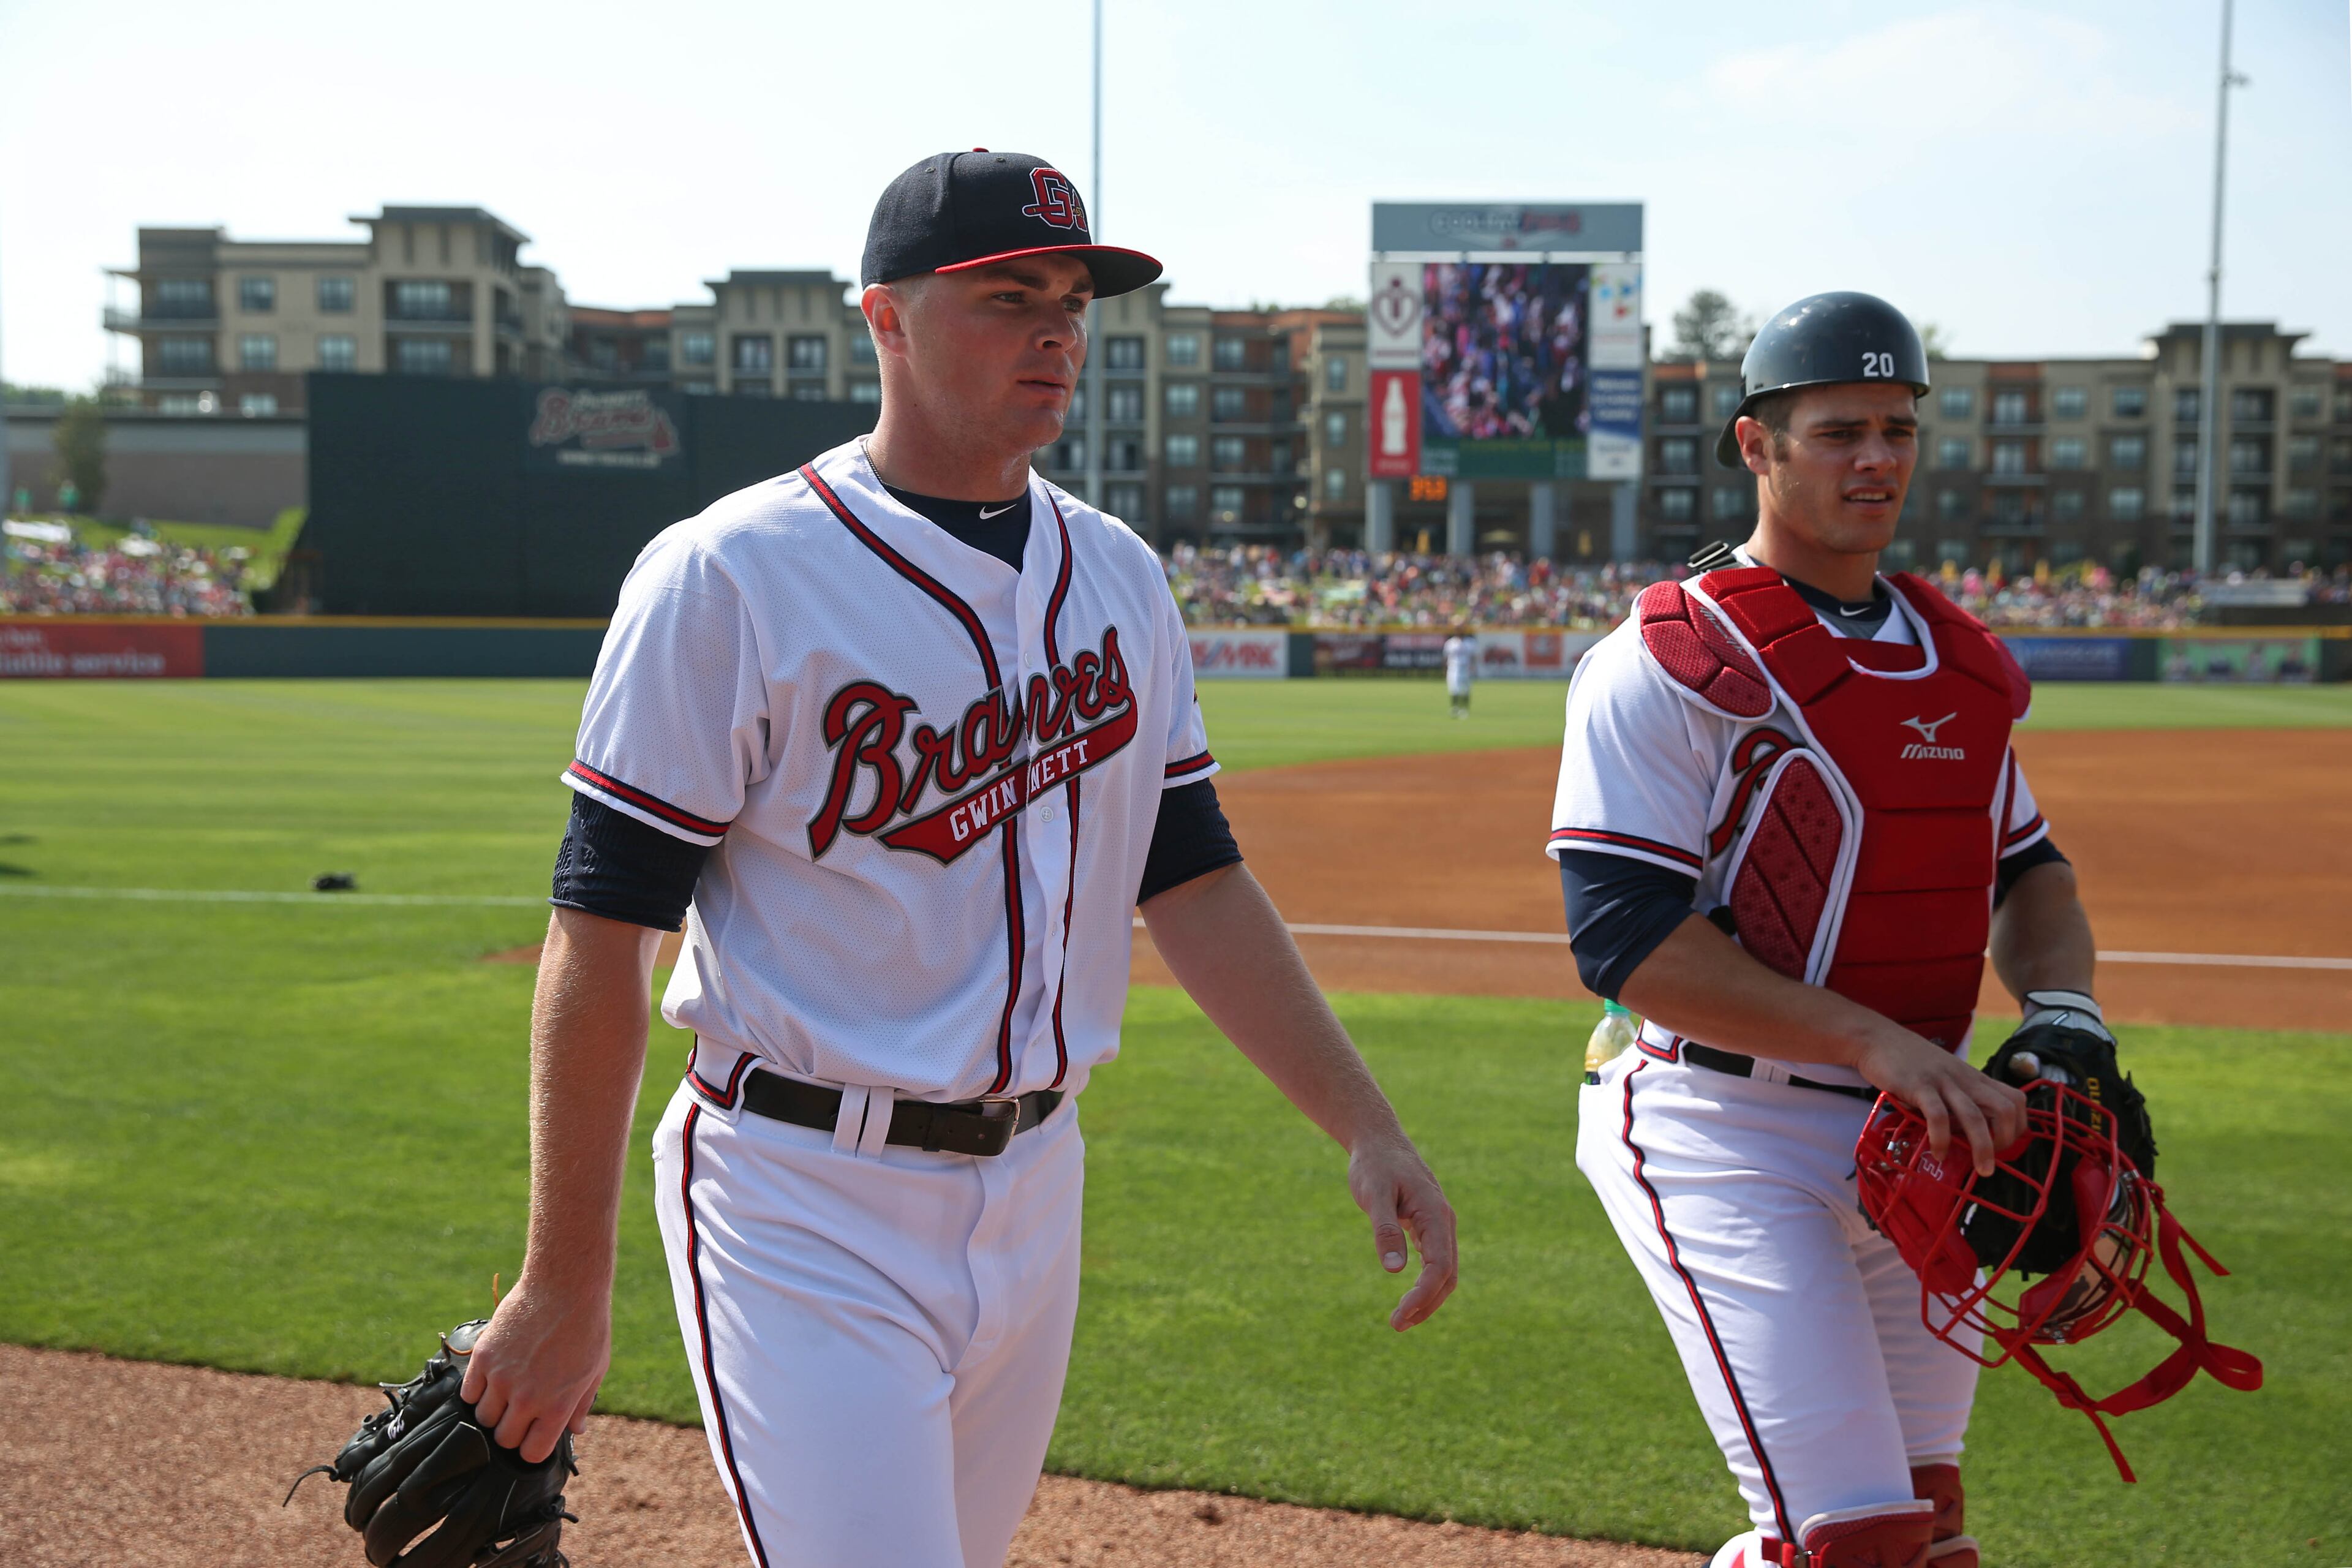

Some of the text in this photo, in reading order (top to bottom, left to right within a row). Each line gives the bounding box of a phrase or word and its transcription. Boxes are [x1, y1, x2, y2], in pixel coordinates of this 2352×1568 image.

[1861, 352, 1895, 378] 20
[807, 624, 1136, 863] Braves
[1900, 743, 1966, 760] MIZUNO
[2087, 1077, 2101, 1139] IZNO
